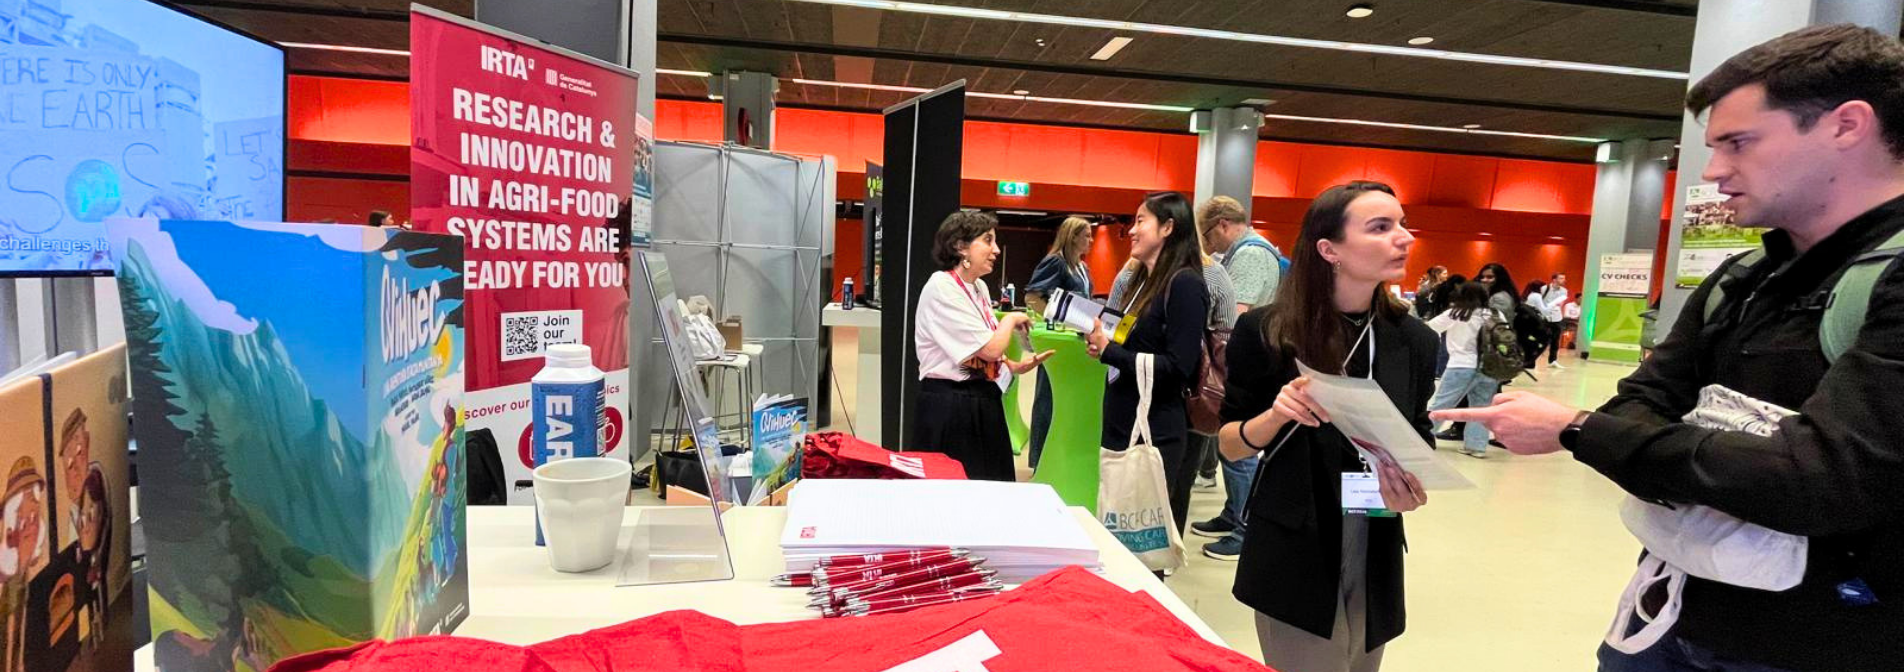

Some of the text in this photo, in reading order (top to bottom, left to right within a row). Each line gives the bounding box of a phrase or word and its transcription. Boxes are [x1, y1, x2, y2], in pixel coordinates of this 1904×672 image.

[2, 57, 151, 90] ERE IS ONLY
[481, 45, 528, 81] IRTA
[42, 88, 145, 129] EARTH
[453, 88, 615, 148] RESEARCH &
[460, 132, 612, 183] INNOVATION
[449, 174, 619, 219] IN AGRI-FOOD
[0, 236, 91, 255] challenges
[447, 216, 620, 253] SYSTEMS ARE
[464, 260, 623, 289] EADY FOR YOU
[543, 315, 570, 326] Join
[543, 329, 565, 339] our
[464, 399, 531, 420] scover our
[546, 395, 573, 463] EAR
